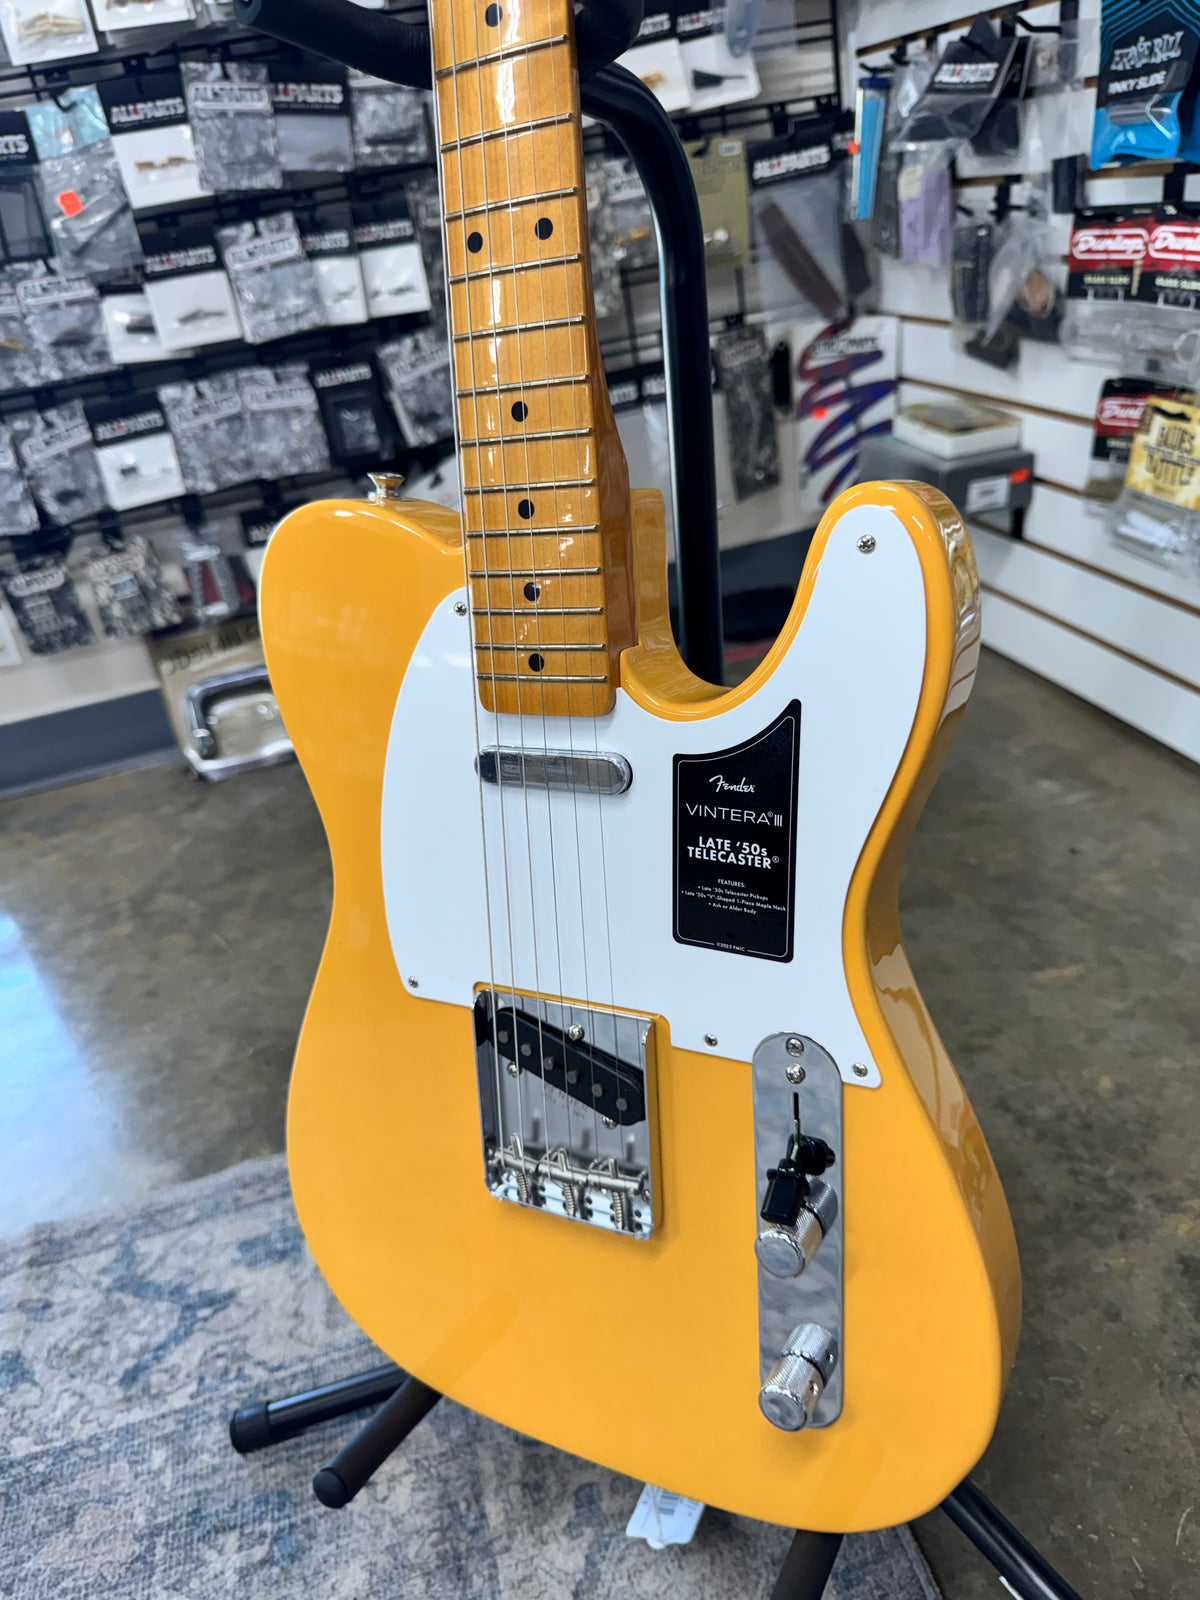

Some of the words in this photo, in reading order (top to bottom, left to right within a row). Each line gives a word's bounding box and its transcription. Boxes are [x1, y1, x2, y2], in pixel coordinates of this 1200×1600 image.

[111, 97, 185, 124] ALLPARTS
[1078, 235, 1146, 255] Dunlop
[709, 774, 756, 793] Fender
[699, 836, 731, 851] LATE
[717, 878, 746, 888] FEATURES:
[724, 888, 749, 898] Telecaster
[749, 892, 769, 902] Pickups
[743, 907, 757, 916] Body
[755, 901, 773, 910] Maple
